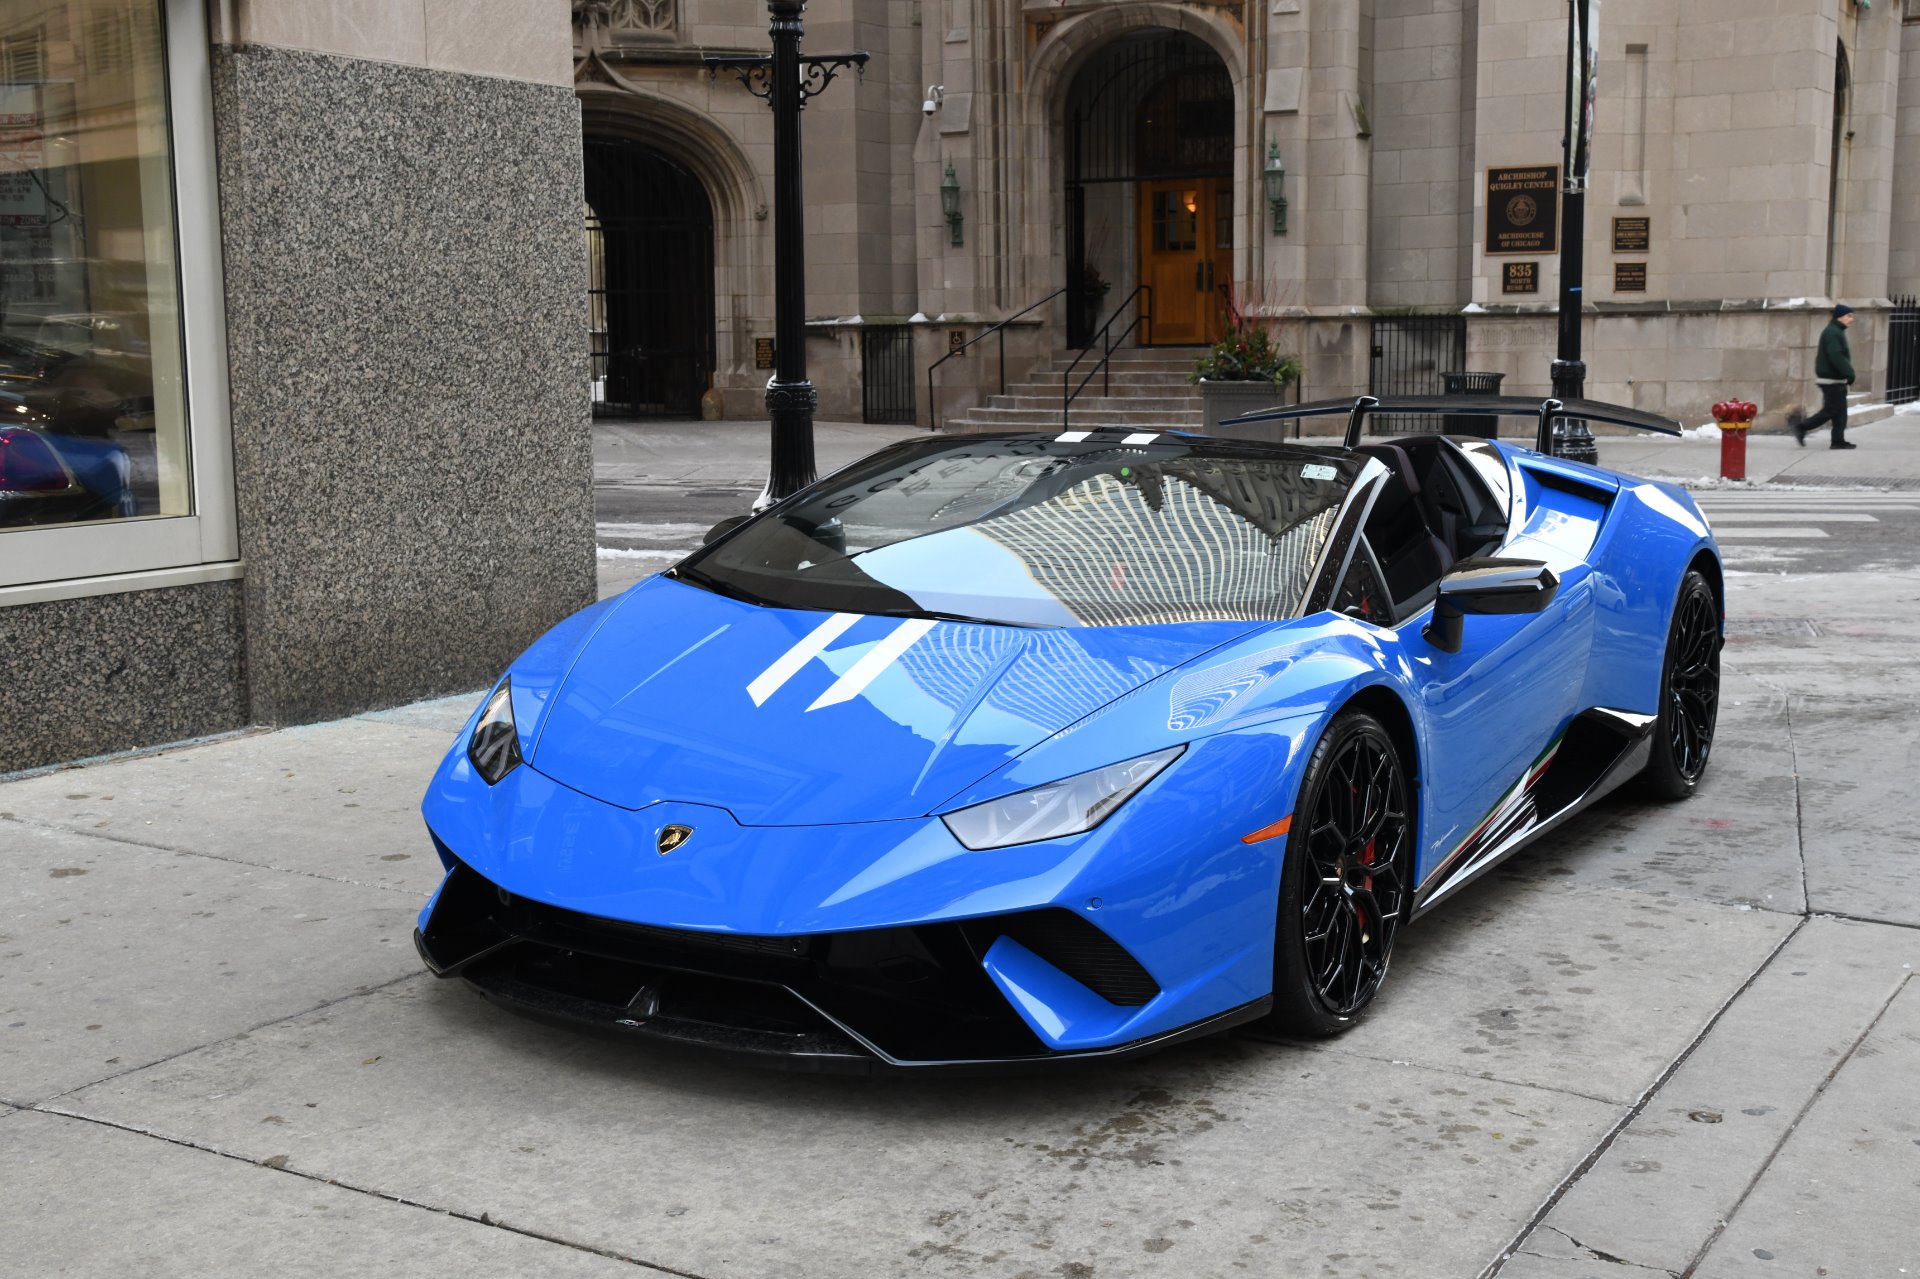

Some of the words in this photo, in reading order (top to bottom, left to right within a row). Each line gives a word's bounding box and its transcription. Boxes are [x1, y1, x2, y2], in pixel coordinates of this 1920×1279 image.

[1497, 171, 1548, 180] ARCHBISHOP
[1489, 181, 1523, 192] QUIGLEY
[1524, 180, 1555, 189] CENTER
[20, 215, 42, 225] ZONE
[1497, 231, 1545, 240] ARCHDIOCESE
[1501, 240, 1510, 248] OF
[1511, 239, 1541, 247] CHICAGO
[1509, 264, 1532, 278] 835
[1506, 284, 1523, 292] RUSH
